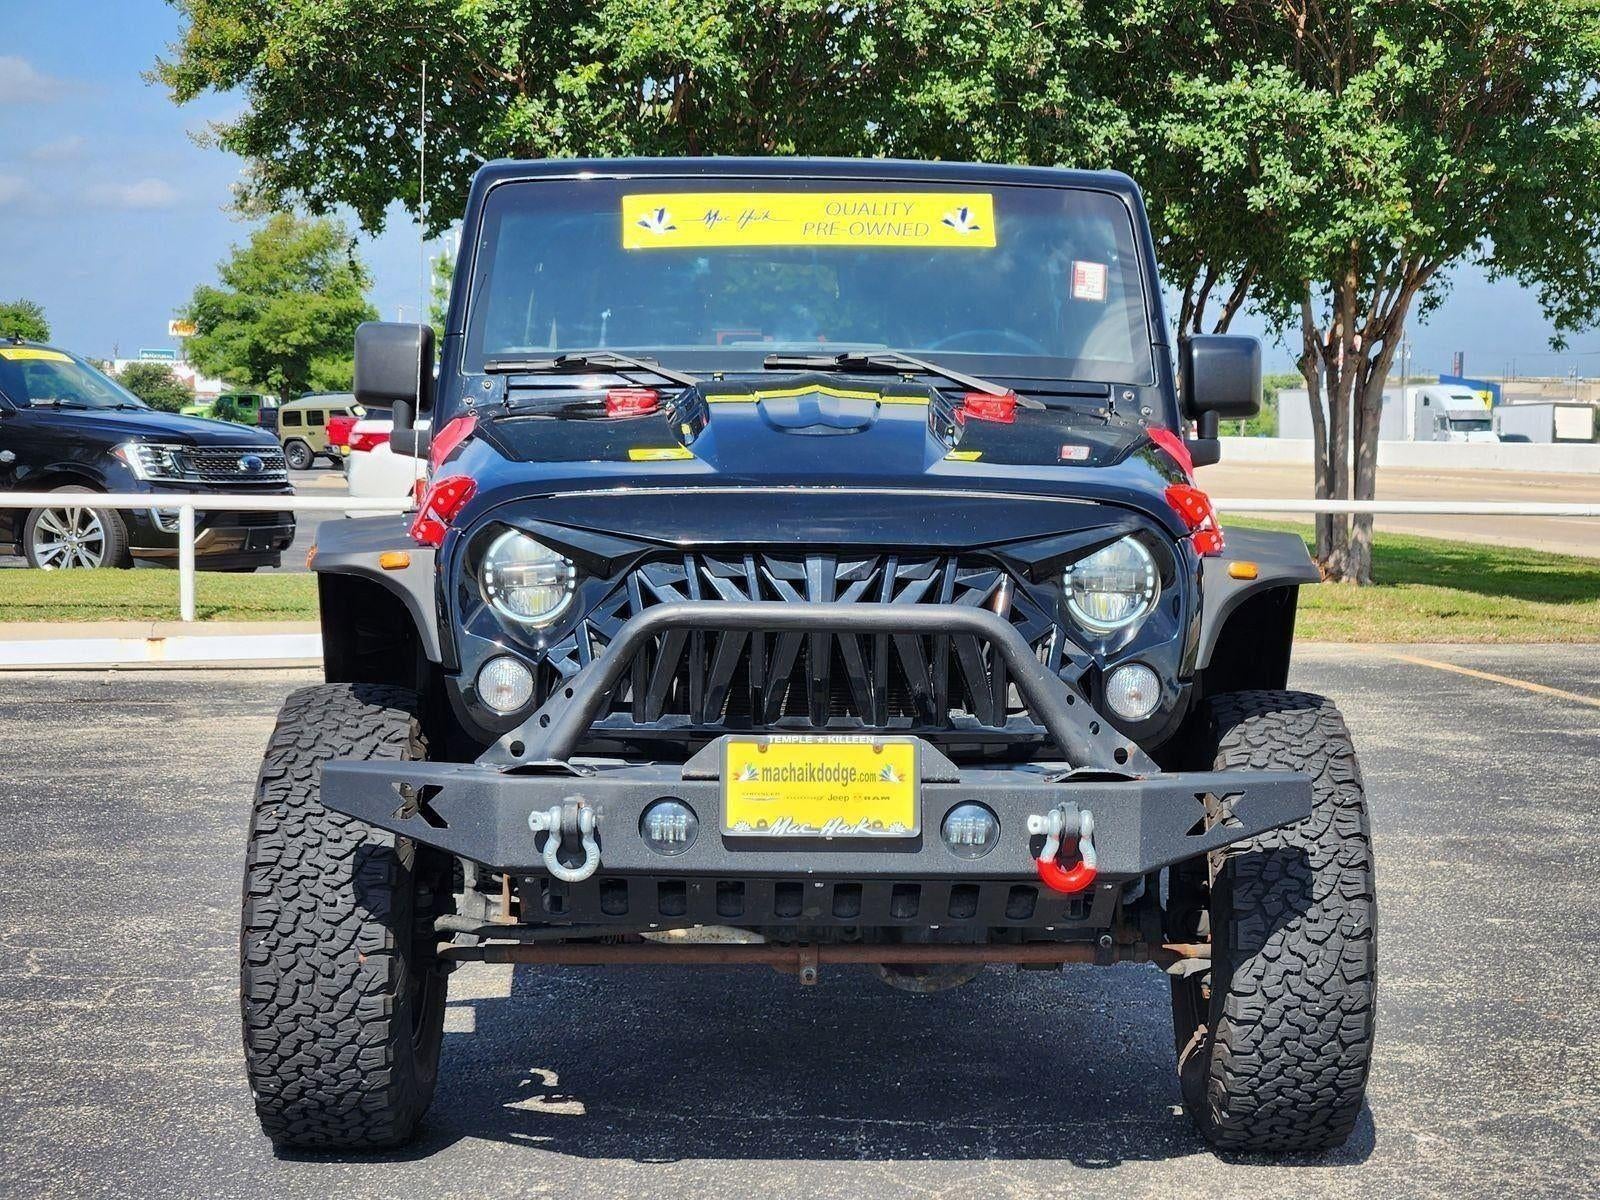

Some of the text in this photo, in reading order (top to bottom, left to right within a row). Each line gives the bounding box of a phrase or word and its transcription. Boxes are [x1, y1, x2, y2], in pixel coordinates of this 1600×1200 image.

[825, 201, 915, 217] QUALITY
[692, 208, 731, 231] Mac
[802, 221, 930, 239] PRE-OWNED
[767, 735, 875, 744] TEMPLE KILLEEN
[760, 762, 877, 787] machaikdodge.com
[827, 794, 850, 802] Jeep
[762, 816, 883, 837] Mac Haik
